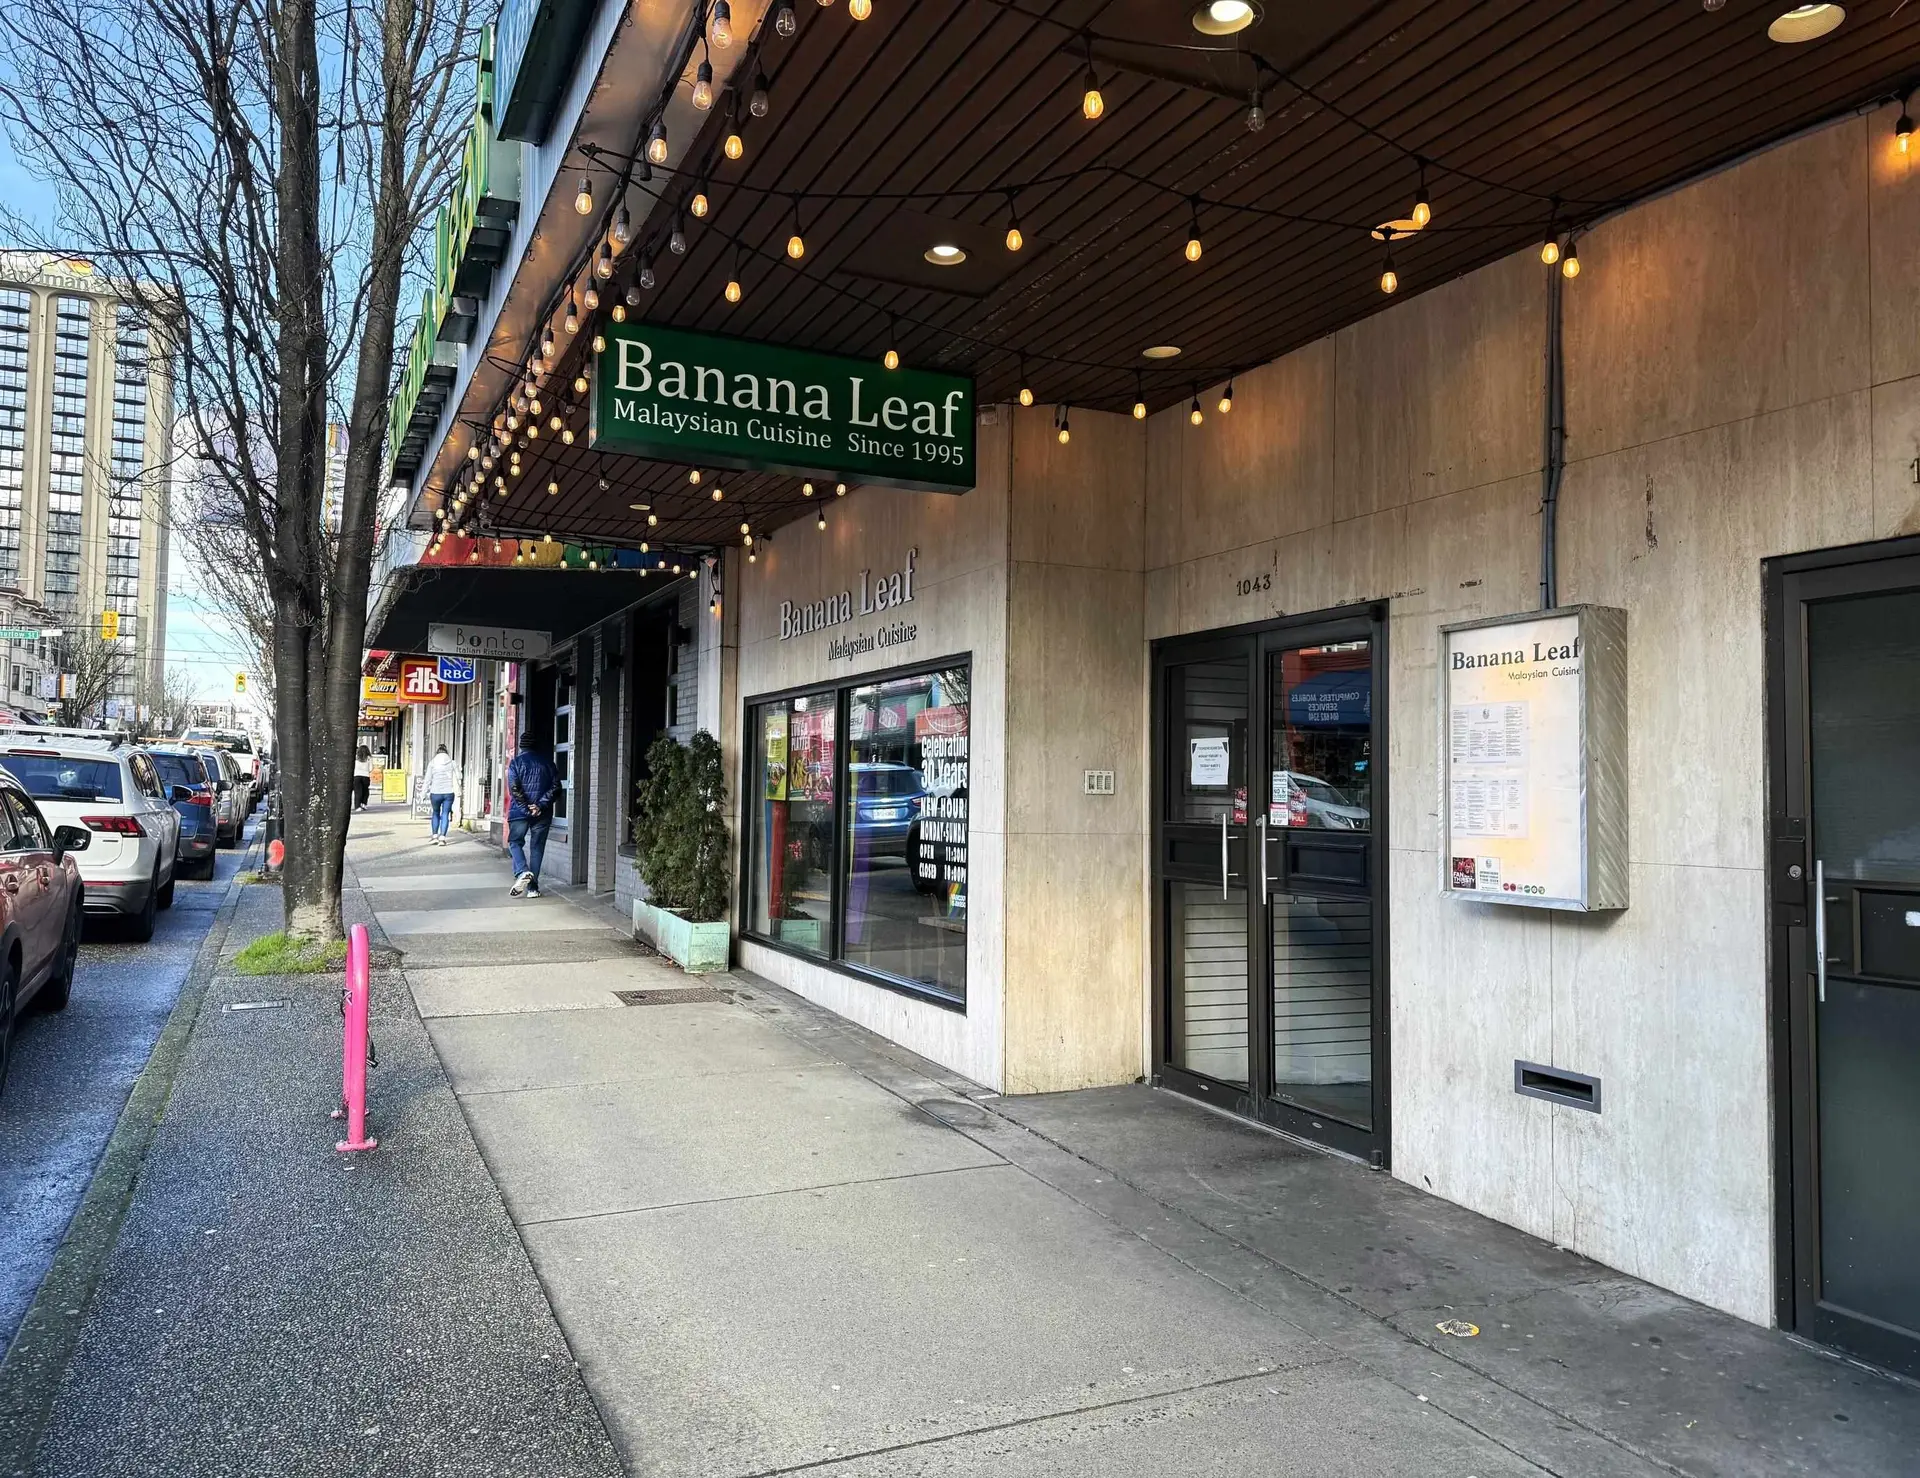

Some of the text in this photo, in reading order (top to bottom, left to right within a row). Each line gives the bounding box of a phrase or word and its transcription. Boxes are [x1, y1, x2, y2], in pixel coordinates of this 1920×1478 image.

[614, 338, 964, 438] Banana Leaf
[613, 397, 964, 466] Malaysian Cuisine Since 1995
[779, 546, 919, 641] Banana Leaf
[1236, 573, 1271, 597] 1043
[456, 627, 525, 650] Bonta
[828, 621, 917, 661] Malaysian Cuisine
[456, 646, 524, 658] Italian Ristorante
[1452, 636, 1579, 670] Banana Leaf
[443, 669, 471, 680] RBC
[921, 759, 967, 789] 30 Years
[920, 797, 938, 818] NEW
[919, 843, 935, 860] OPEN
[919, 862, 937, 880] CLOSED
